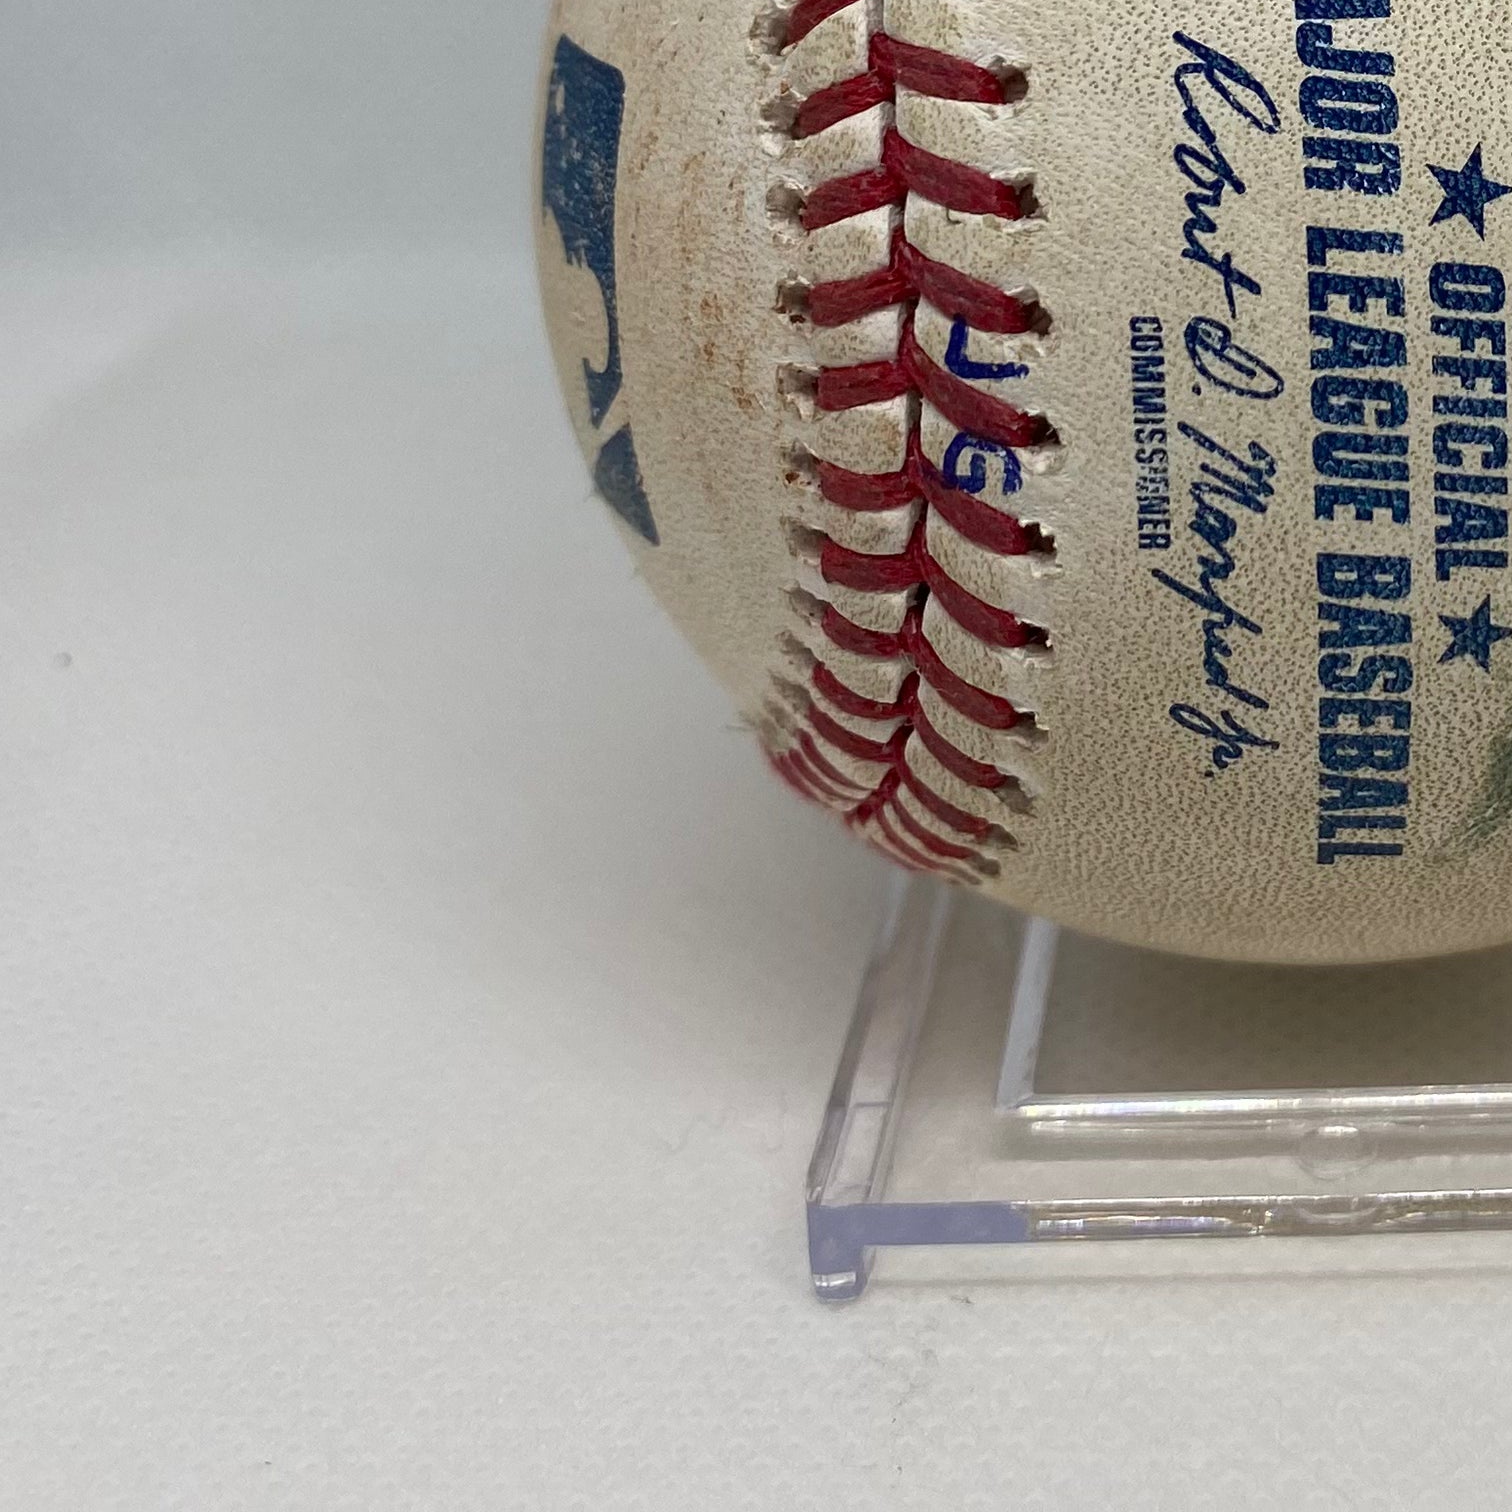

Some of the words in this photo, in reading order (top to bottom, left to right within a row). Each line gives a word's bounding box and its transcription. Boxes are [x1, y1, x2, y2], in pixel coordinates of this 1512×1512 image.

[1305, 225, 1411, 525] LEAGUE
[1429, 261, 1510, 582] OFFICIAL
[1315, 552, 1414, 865] BASEBALL
